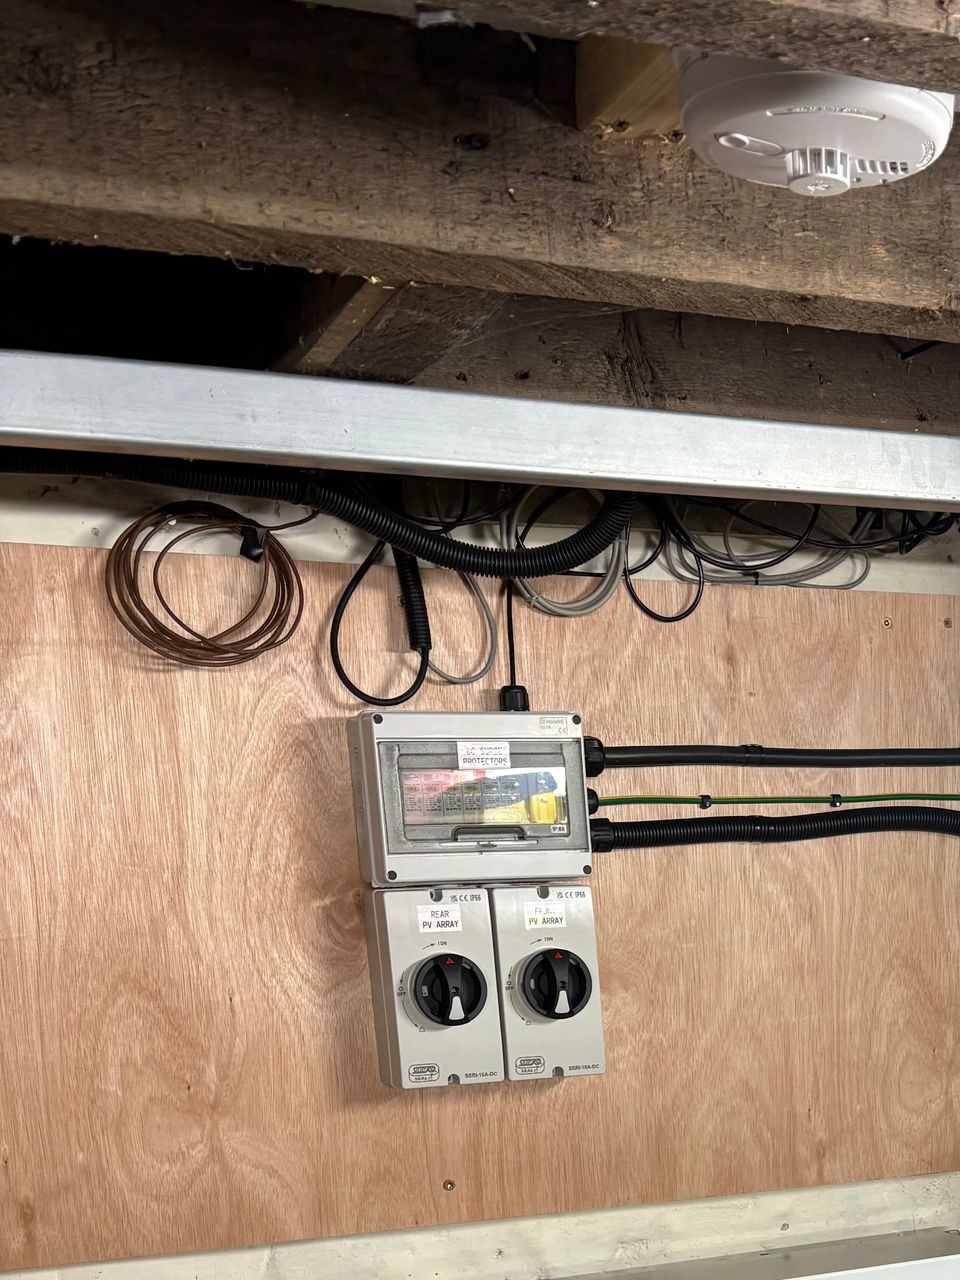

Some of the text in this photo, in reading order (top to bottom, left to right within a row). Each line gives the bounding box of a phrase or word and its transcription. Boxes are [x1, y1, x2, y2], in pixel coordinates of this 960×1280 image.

[463, 757, 508, 766] PROTECTORS
[430, 910, 450, 918] REAR
[436, 920, 459, 928] ARRAY
[529, 916, 564, 925] PV ARRAY
